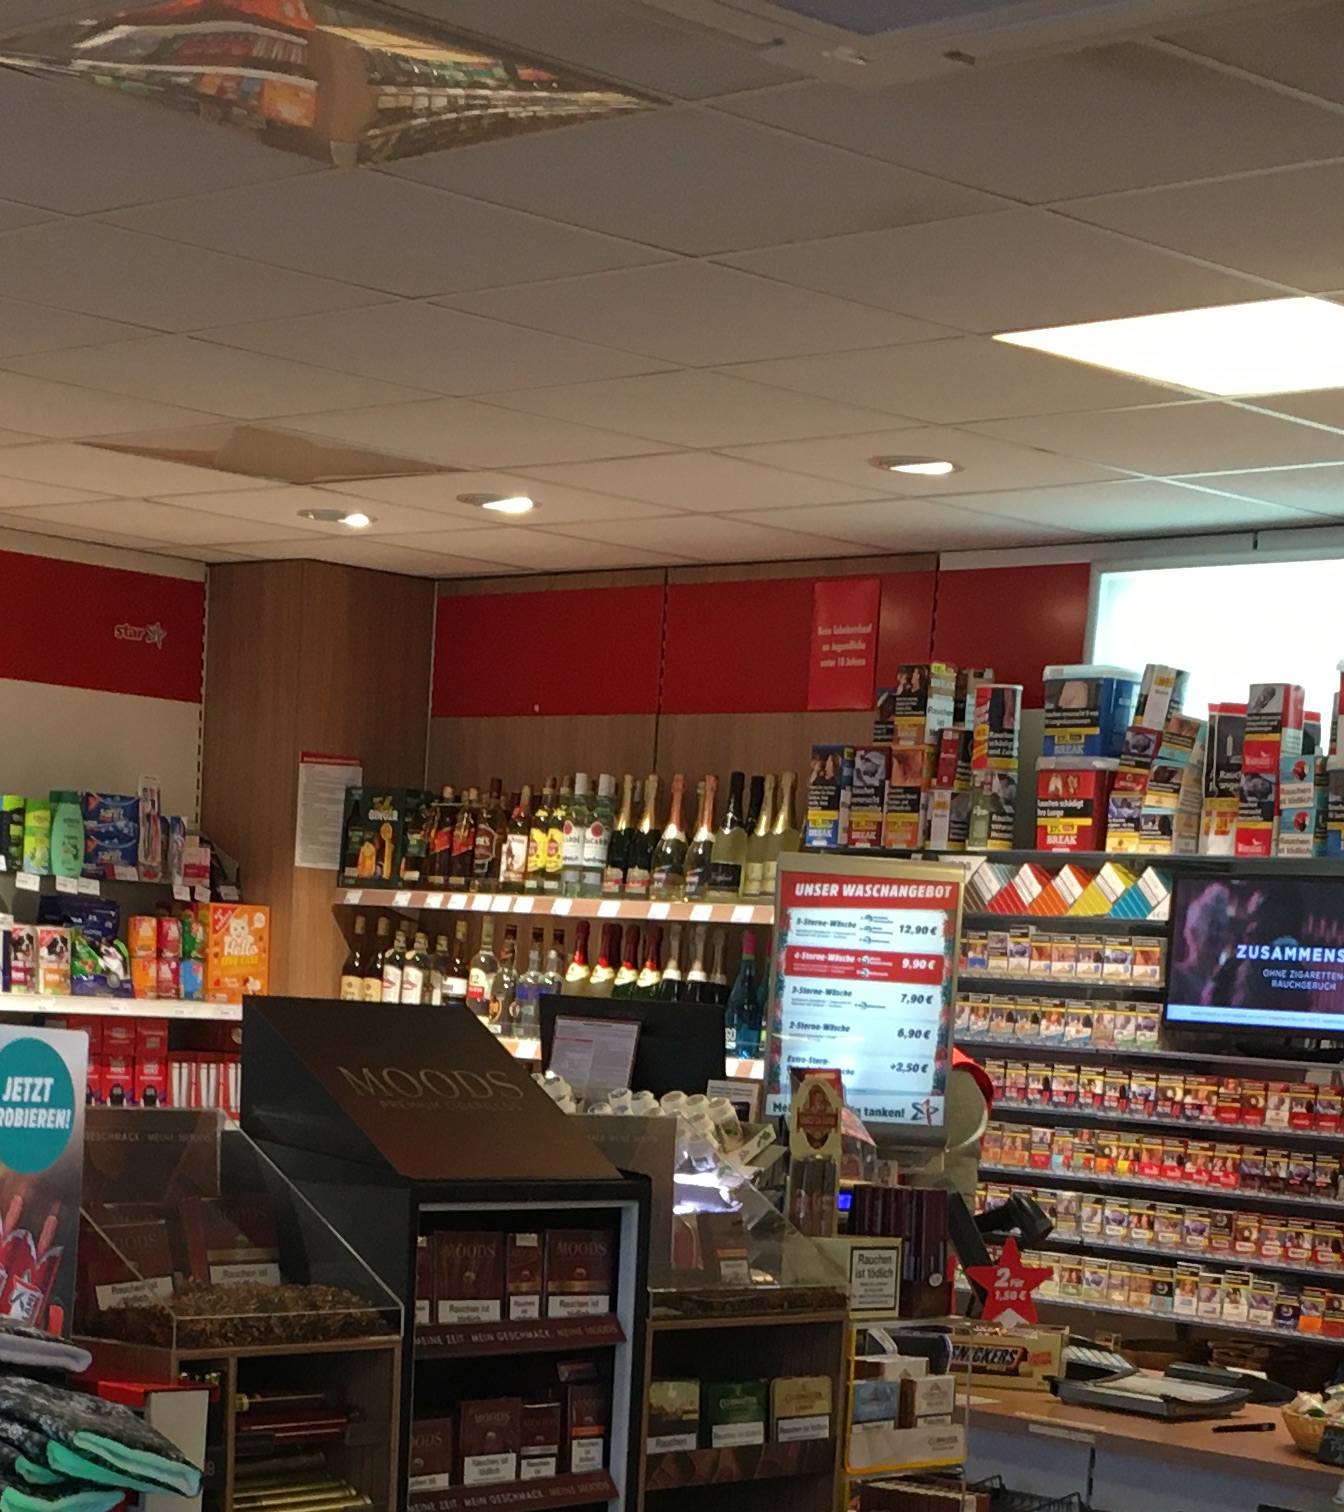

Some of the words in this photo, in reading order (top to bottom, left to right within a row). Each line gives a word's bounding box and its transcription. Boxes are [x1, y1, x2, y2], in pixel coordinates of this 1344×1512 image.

[114, 623, 145, 641] star
[1047, 835, 1077, 845] BREAK
[795, 882, 839, 897] UNSER
[842, 884, 952, 900] WASCHANGEBOT
[899, 924, 929, 936] 12,90
[930, 925, 938, 936] €
[224, 934, 259, 957] Hello
[902, 959, 927, 970] 9,90
[928, 960, 936, 970] €
[1263, 968, 1286, 978] OHNE
[1271, 980, 1337, 991] RAUCHGERUCH
[901, 994, 925, 1005] 7,90
[925, 994, 934, 1005] €
[897, 1028, 922, 1040] 6,90
[923, 1029, 931, 1040] €
[890, 1062, 919, 1074] +2,50
[920, 1063, 929, 1073] €
[338, 1066, 524, 1099] MOODS
[2, 1077, 54, 1103] JETZT
[864, 1105, 905, 1118] tanken!
[557, 1241, 607, 1256] MOODS
[858, 1254, 892, 1265] Rauchen
[867, 1268, 894, 1279] tödlich
[994, 1268, 1011, 1287] 2
[1019, 1291, 1027, 1301] €
